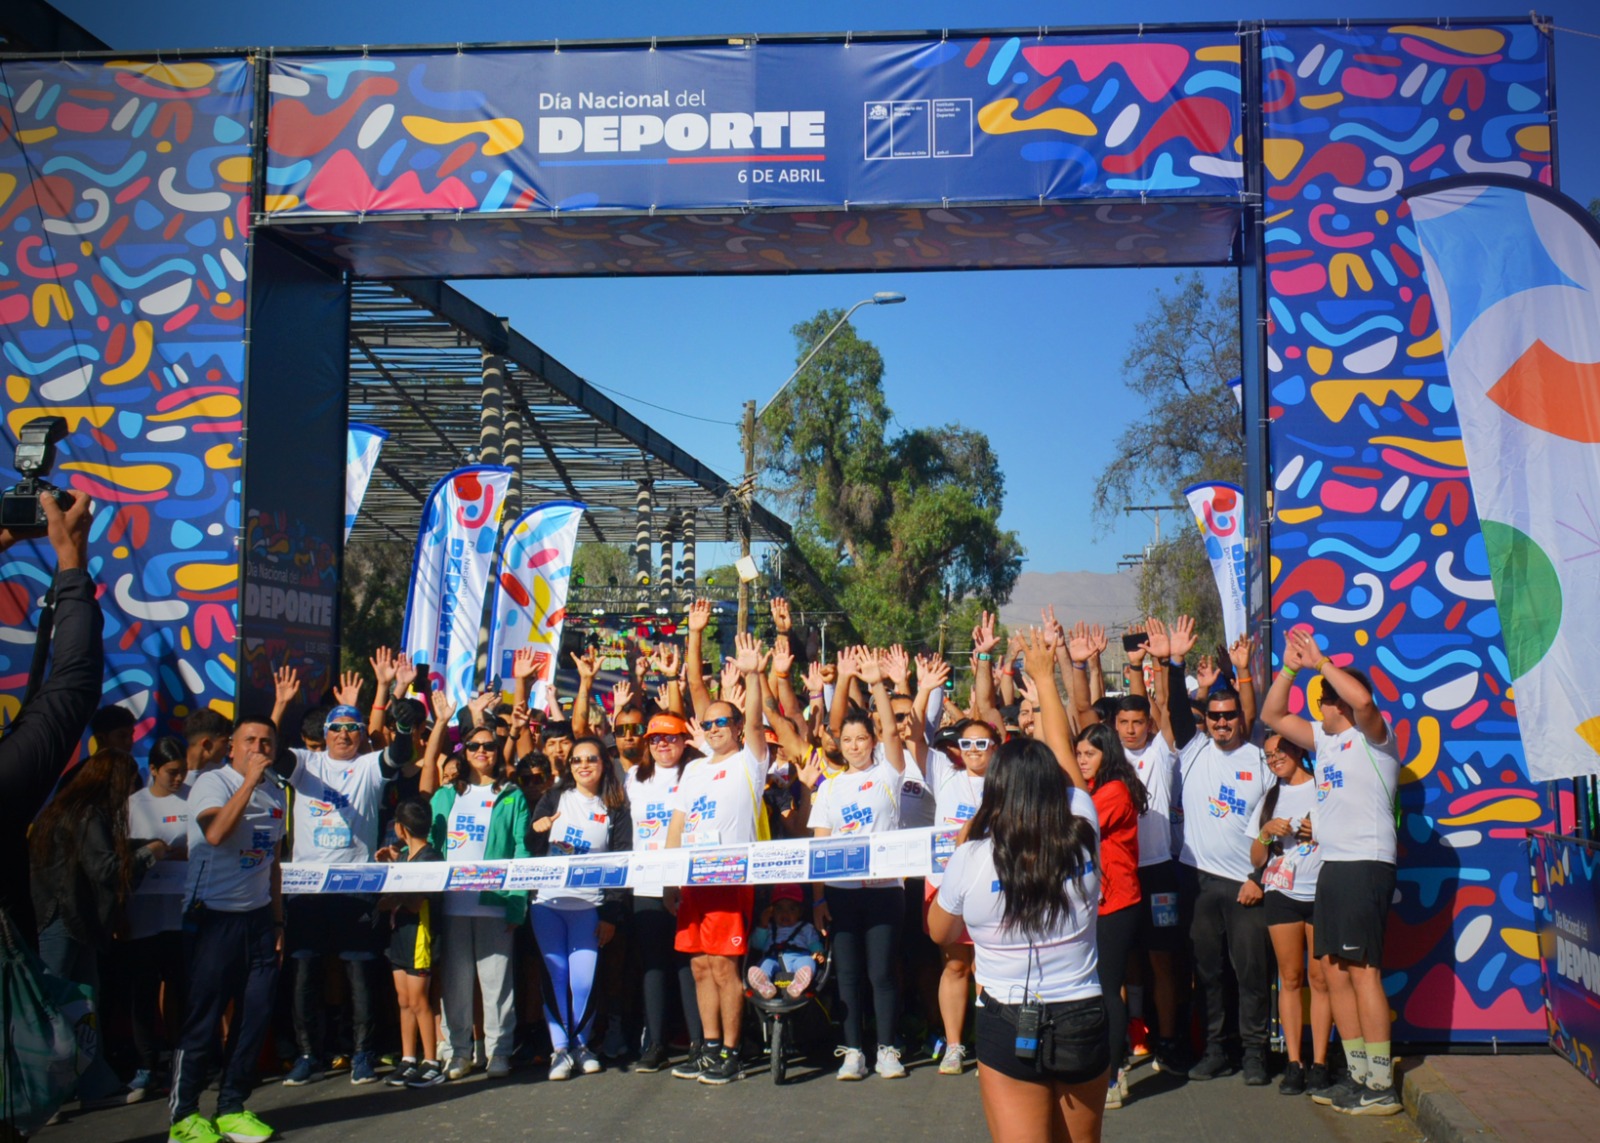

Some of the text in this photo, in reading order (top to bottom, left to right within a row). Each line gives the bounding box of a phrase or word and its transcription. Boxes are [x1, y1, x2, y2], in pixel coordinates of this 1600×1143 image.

[539, 88, 706, 110] Día Nacional del
[538, 110, 826, 154] DEPORTE
[737, 167, 825, 184] 6 DE ABRIL
[246, 560, 257, 577] Día
[258, 563, 288, 583] Nacional
[244, 582, 333, 627] DEPORTE
[436, 538, 464, 665] DEPORTE
[1332, 779, 1344, 788] TE
[1220, 784, 1236, 797] DE
[1219, 792, 1247, 808] POR
[646, 803, 665, 811] DE
[841, 801, 859, 816] DE
[1230, 805, 1246, 816] TE
[456, 815, 476, 824] DE
[701, 810, 716, 820] TE
[843, 807, 872, 823] POR
[859, 815, 874, 826] TE
[956, 811, 975, 819] PO
[456, 824, 486, 833] POR
[661, 819, 671, 827] T
[469, 833, 485, 842] TE
[566, 826, 584, 838] DE
[563, 835, 592, 849] POR
[692, 864, 745, 874] DEPORTE
[753, 859, 805, 868] DEPORTE
[1562, 912, 1580, 938] Nacional
[1556, 935, 1600, 997] DEPOR
